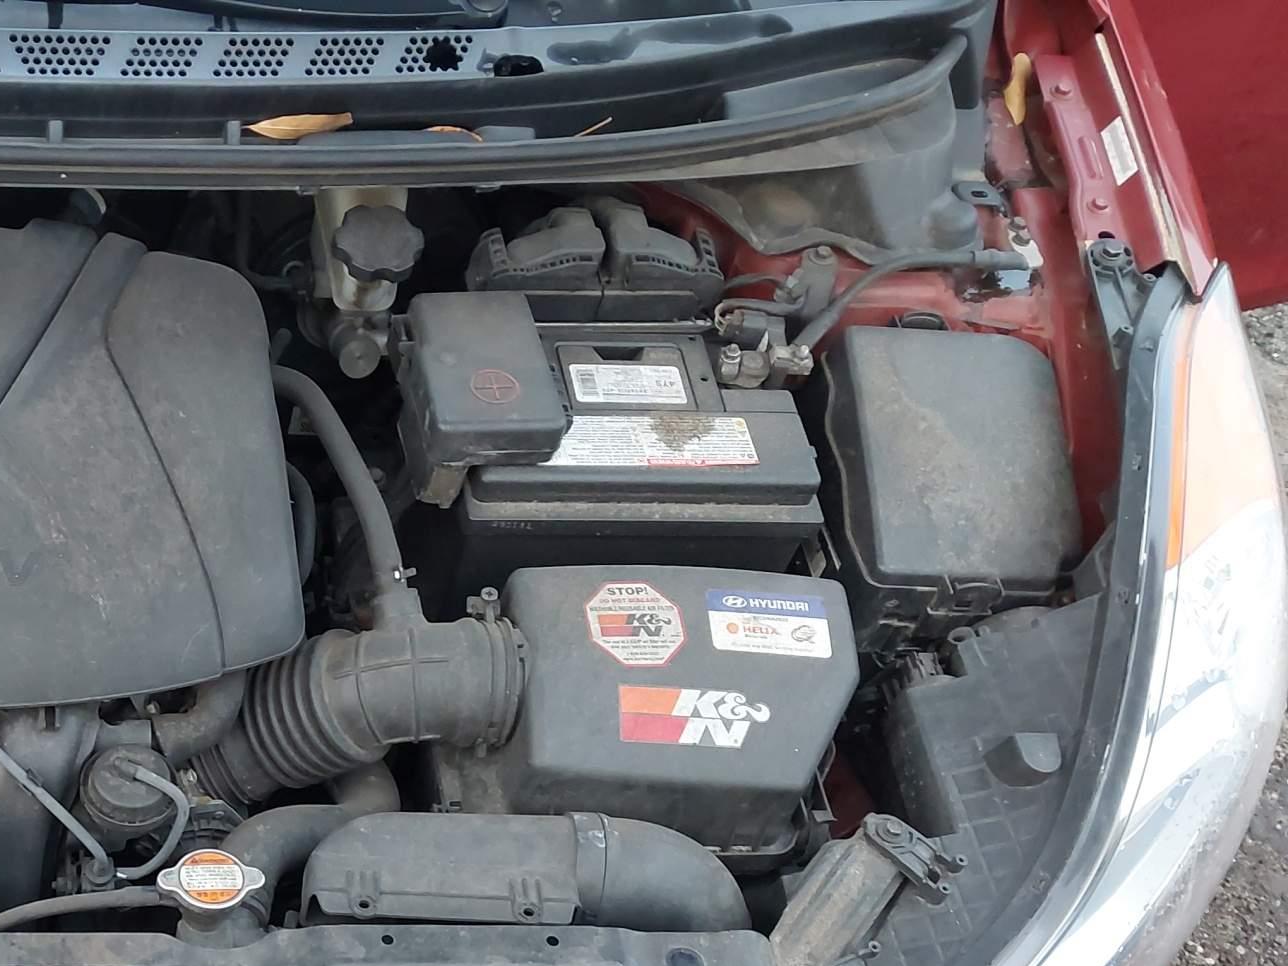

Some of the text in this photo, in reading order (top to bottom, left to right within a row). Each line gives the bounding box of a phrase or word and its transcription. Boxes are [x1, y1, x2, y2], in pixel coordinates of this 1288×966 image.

[607, 586, 649, 595] STOP!
[749, 598, 809, 612] HYUNDAI
[743, 625, 777, 635] HELIX
[671, 689, 771, 748] K&N
